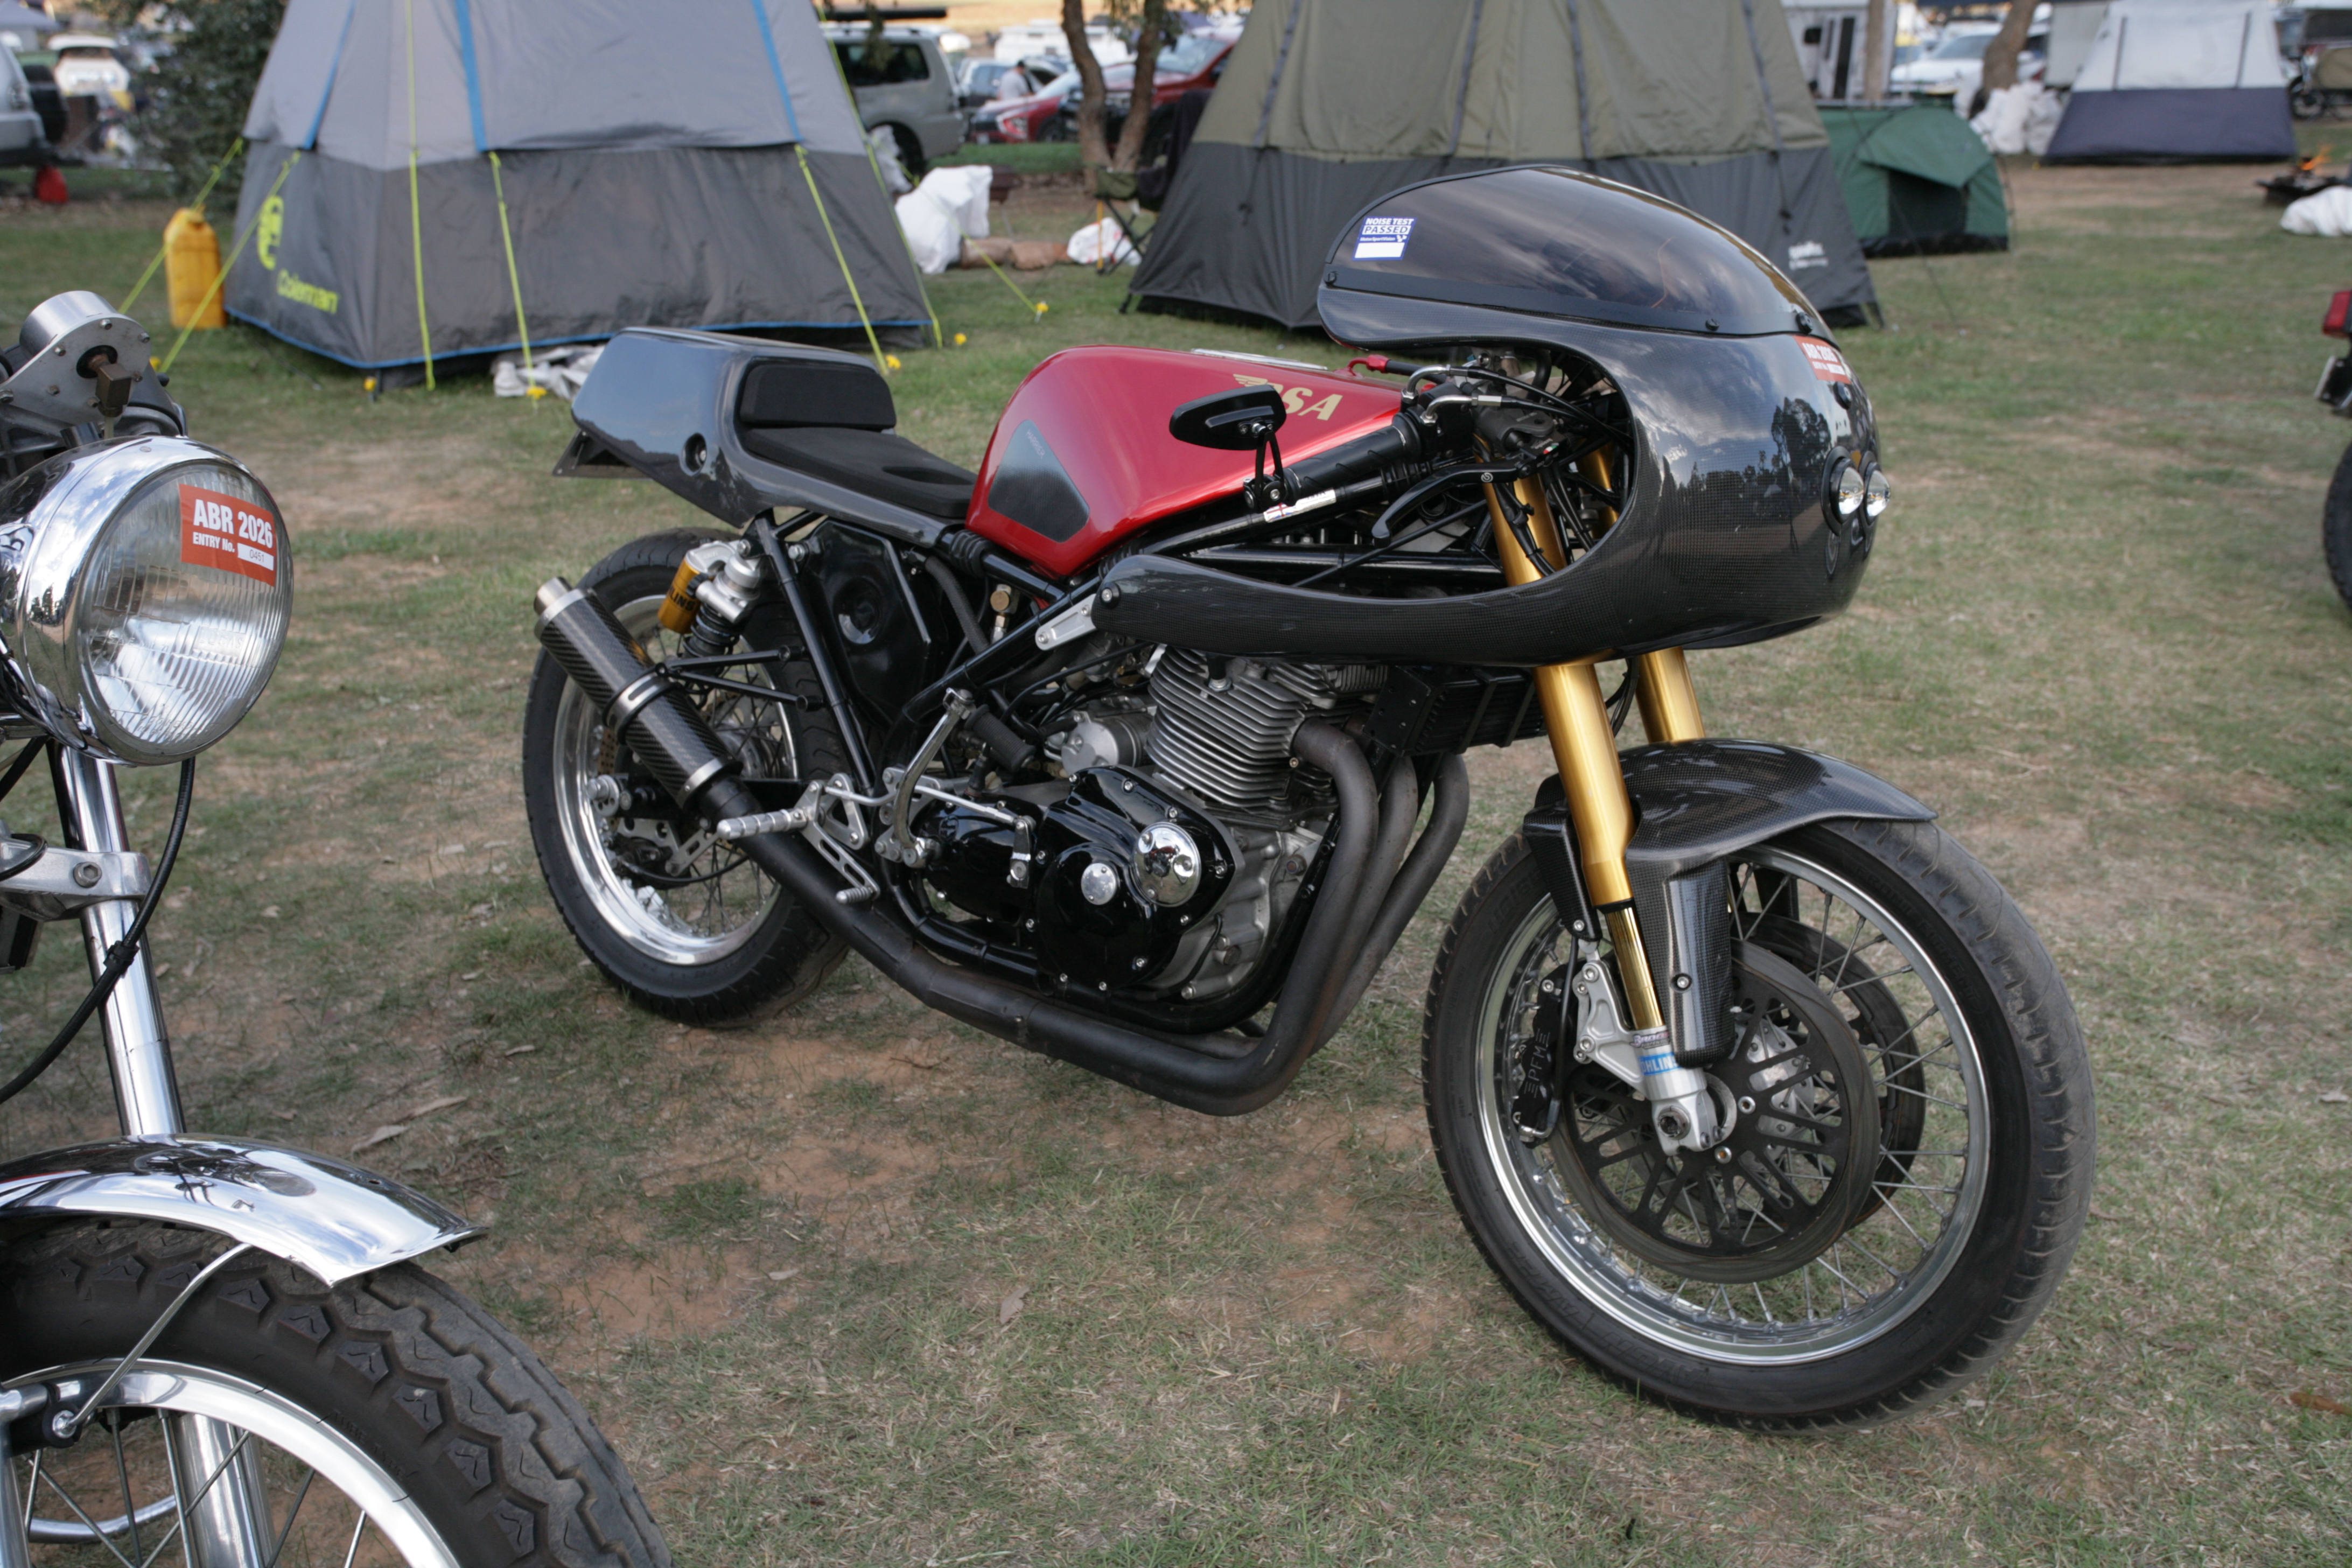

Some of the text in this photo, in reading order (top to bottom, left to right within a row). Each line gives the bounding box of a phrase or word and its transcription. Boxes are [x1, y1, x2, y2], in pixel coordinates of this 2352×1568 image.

[277, 269, 338, 314] Coleman
[193, 499, 273, 549] ABR 2026
[193, 531, 235, 552] ENTRY No.
[249, 549, 264, 563] 0451
[1528, 1045, 1546, 1081] PFM
